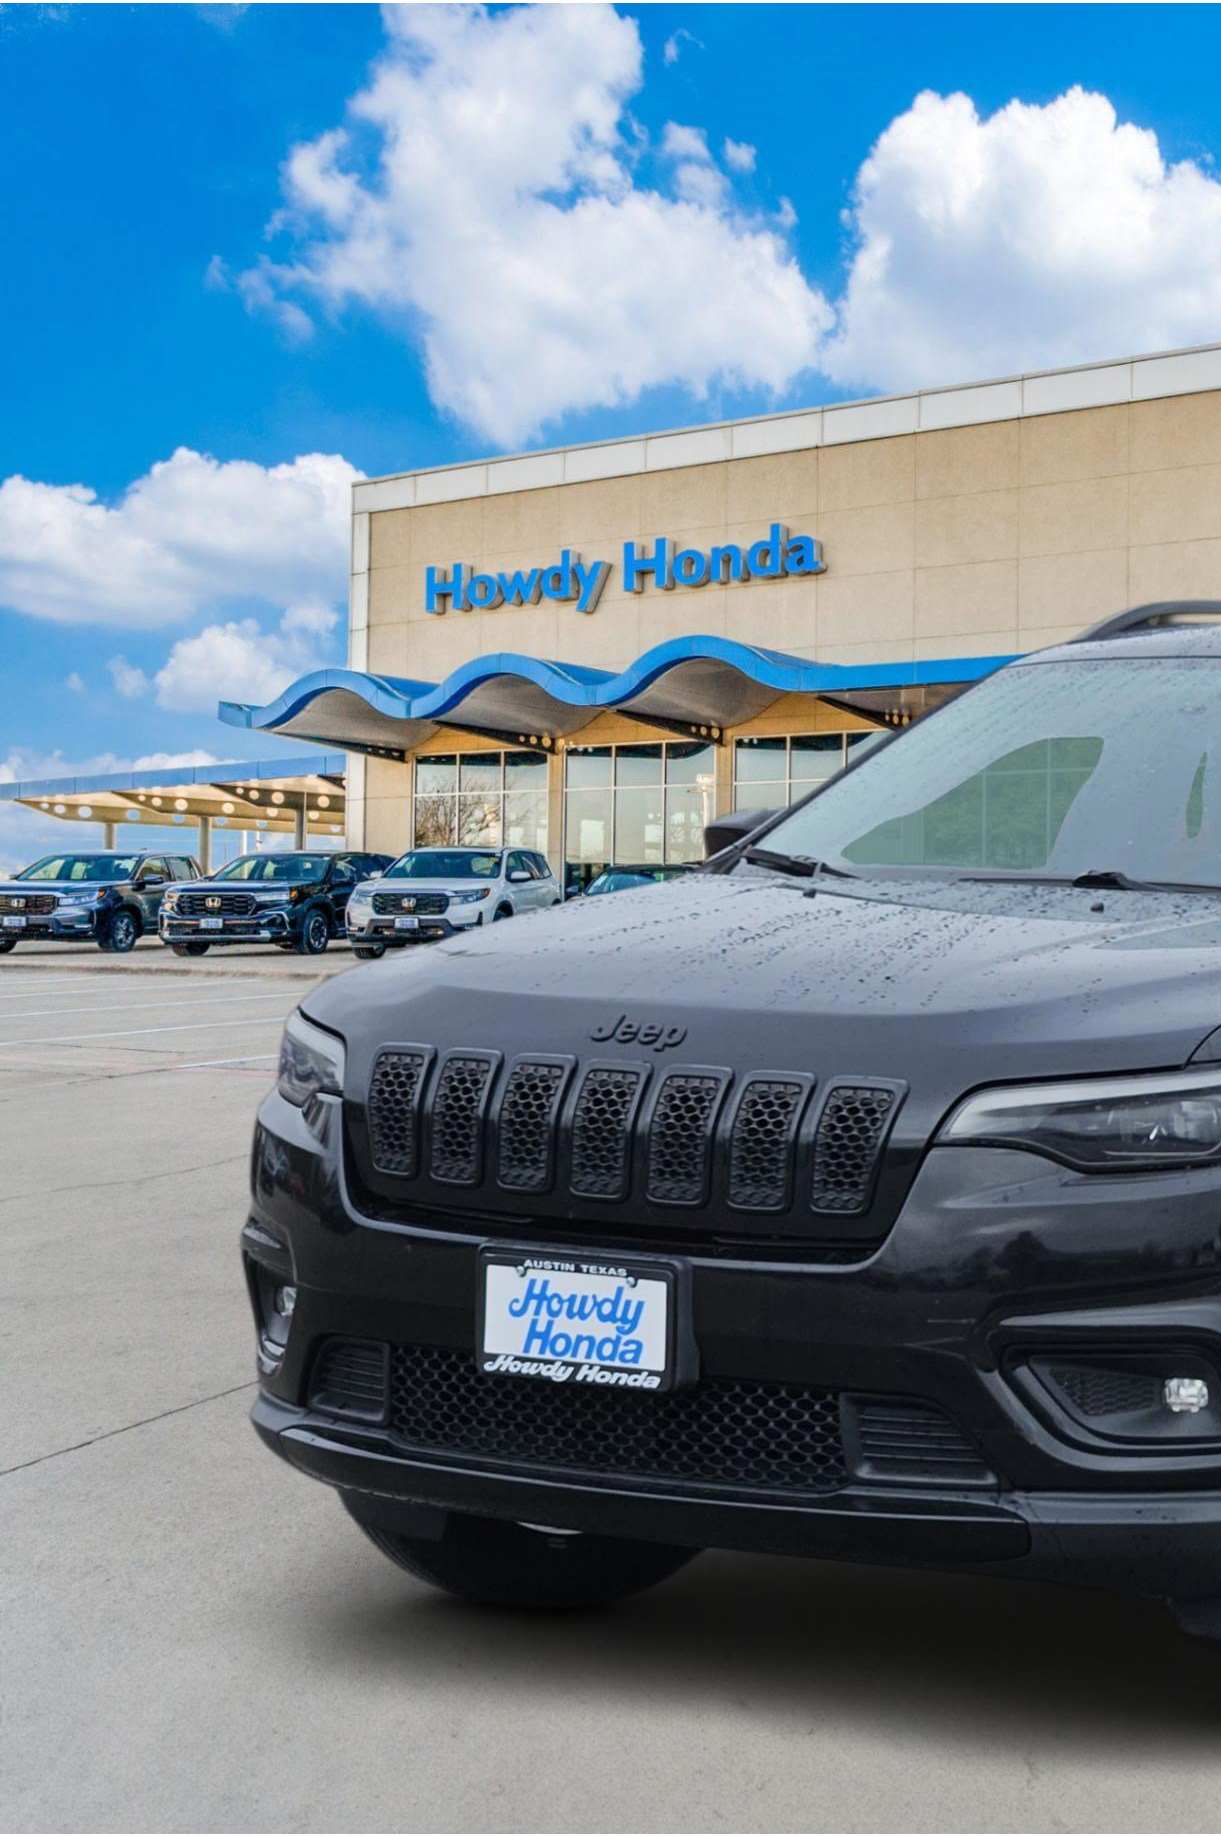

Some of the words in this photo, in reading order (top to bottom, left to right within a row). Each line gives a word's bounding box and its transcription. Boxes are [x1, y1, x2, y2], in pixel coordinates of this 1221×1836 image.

[425, 548, 612, 614] Howdy
[623, 523, 827, 593] Honda
[590, 1014, 688, 1052] Jeep
[523, 1259, 575, 1272] AUSTIN
[581, 1264, 628, 1277] TEXAS
[508, 1278, 645, 1335] Howdy
[523, 1319, 643, 1364] Honda
[484, 1355, 574, 1382] Howdy
[576, 1364, 661, 1389] Honda
